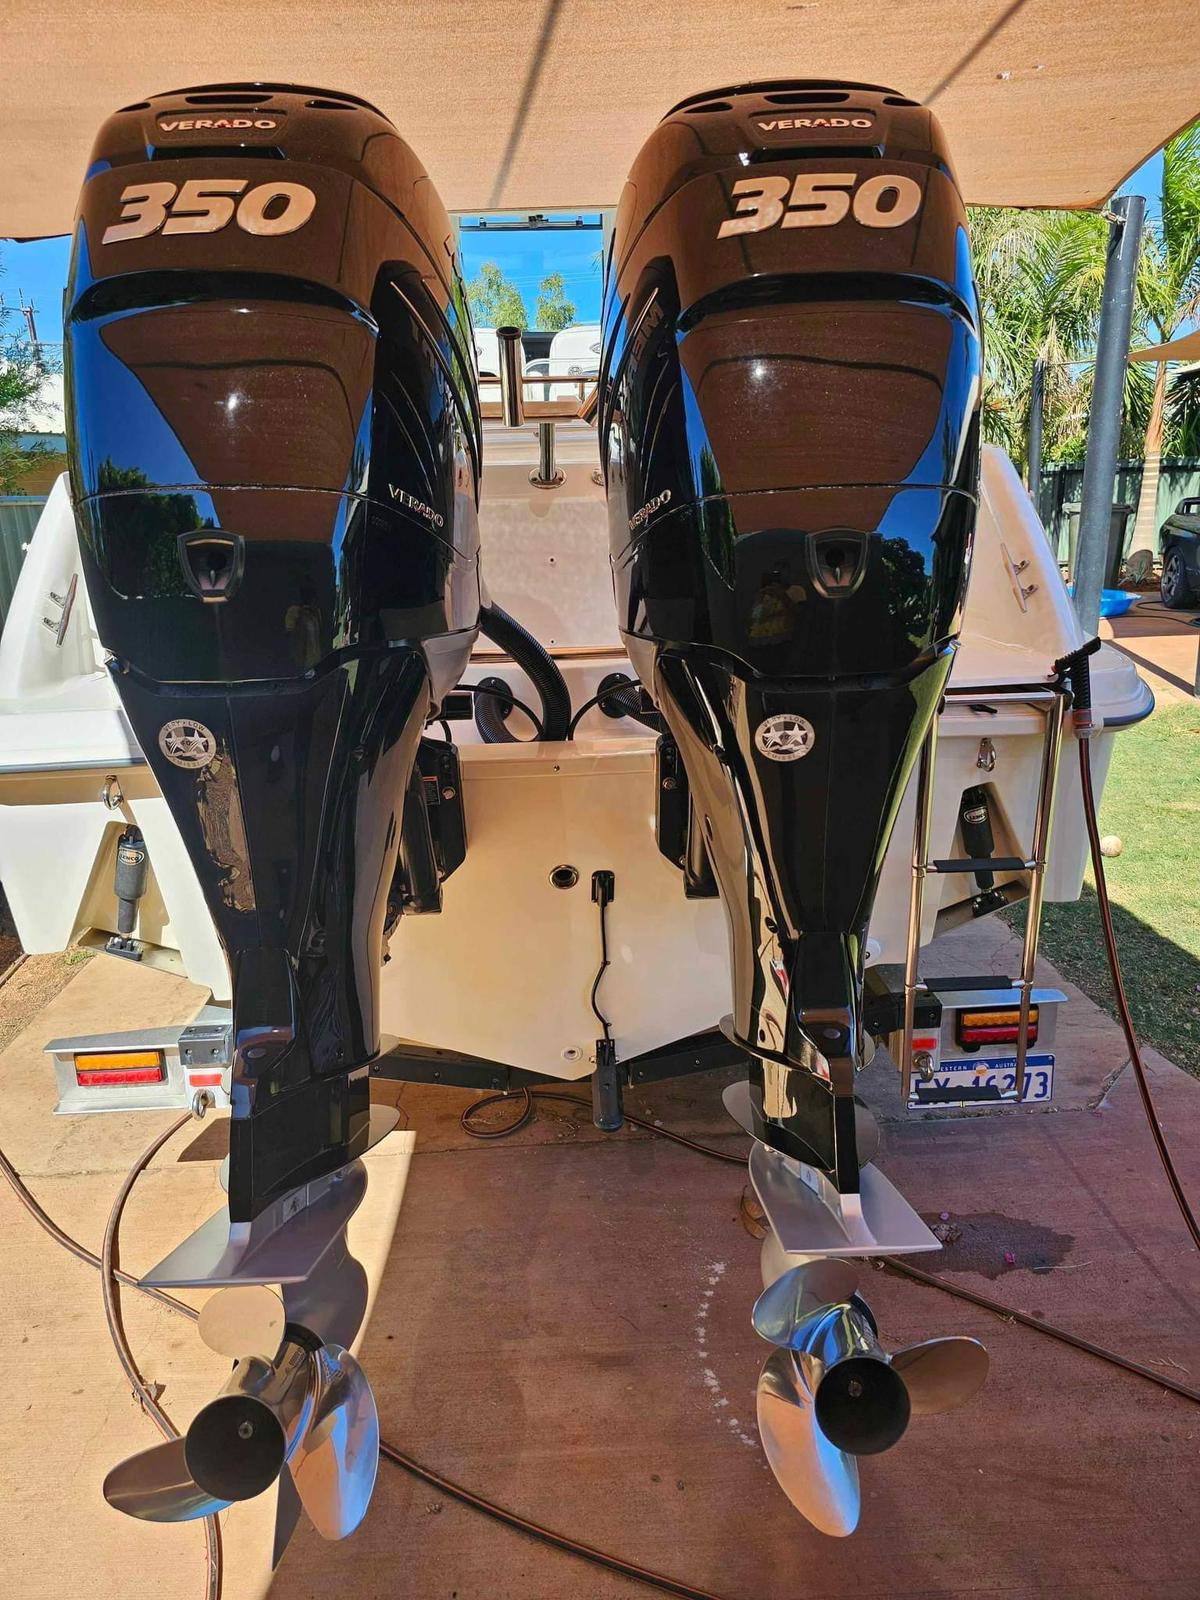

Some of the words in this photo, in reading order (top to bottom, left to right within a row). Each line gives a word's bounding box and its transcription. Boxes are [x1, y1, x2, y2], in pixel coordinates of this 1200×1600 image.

[159, 119, 277, 132] VERADO
[758, 118, 873, 131] VERADO
[101, 179, 317, 245] 350
[715, 172, 922, 240] 350
[388, 483, 444, 528] VERADO
[188, 721, 205, 731] LOW
